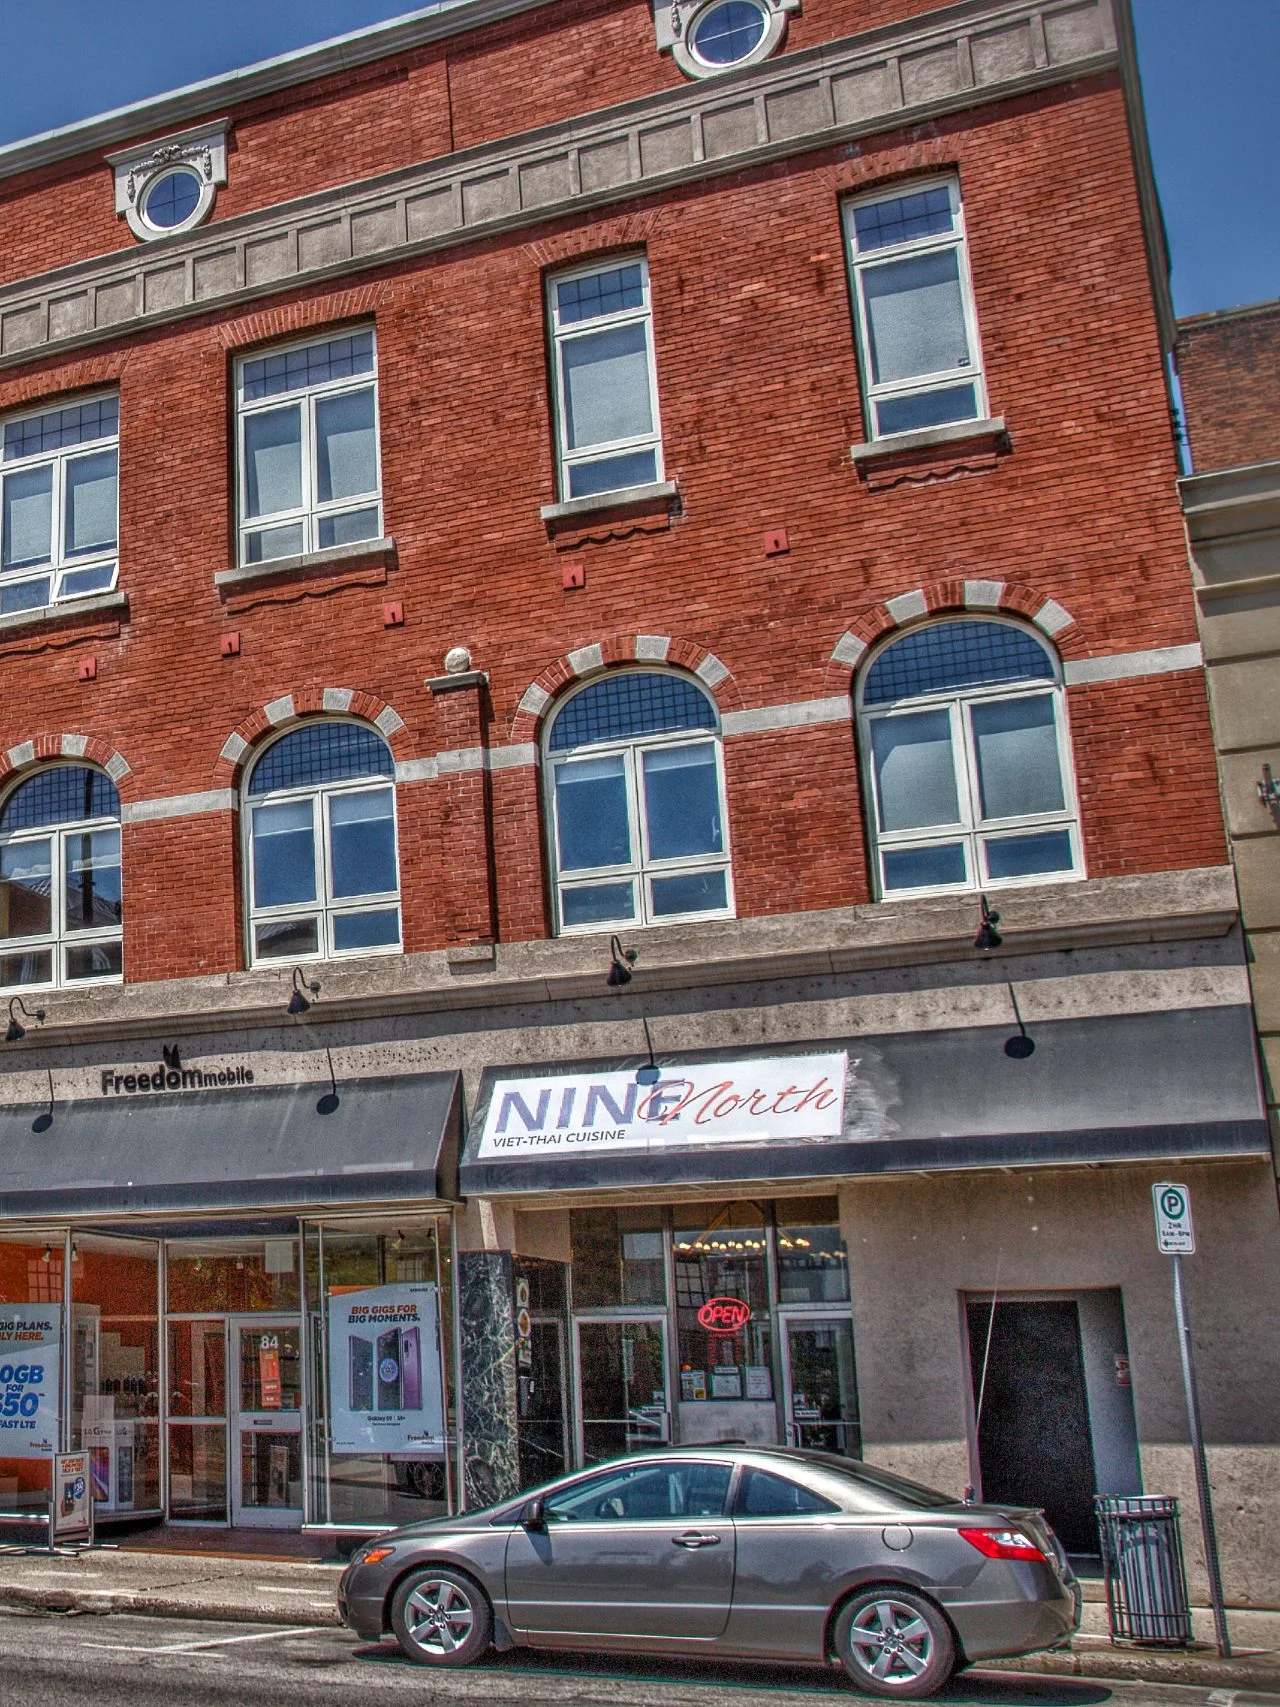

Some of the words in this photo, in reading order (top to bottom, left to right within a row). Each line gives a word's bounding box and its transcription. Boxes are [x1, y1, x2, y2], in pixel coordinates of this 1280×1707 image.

[101, 1064, 204, 1095] Freedom
[204, 1065, 254, 1087] mobile
[494, 1078, 686, 1134] NINE
[637, 1075, 840, 1127] North
[493, 1132, 562, 1148] VIET-THAI
[566, 1129, 626, 1143] CUISINE
[351, 1305, 369, 1315] BIG
[371, 1304, 395, 1315] GIGS
[396, 1304, 417, 1313] FOR
[701, 1304, 746, 1324] OPEN
[348, 1314, 366, 1324] BIG
[368, 1312, 420, 1323] MOMENTS.
[16, 1321, 52, 1331] PLANS.
[14, 1331, 44, 1341] HERE.
[261, 1335, 279, 1349] 84
[6, 1384, 24, 1393] FOR
[20, 1420, 36, 1429] LTE
